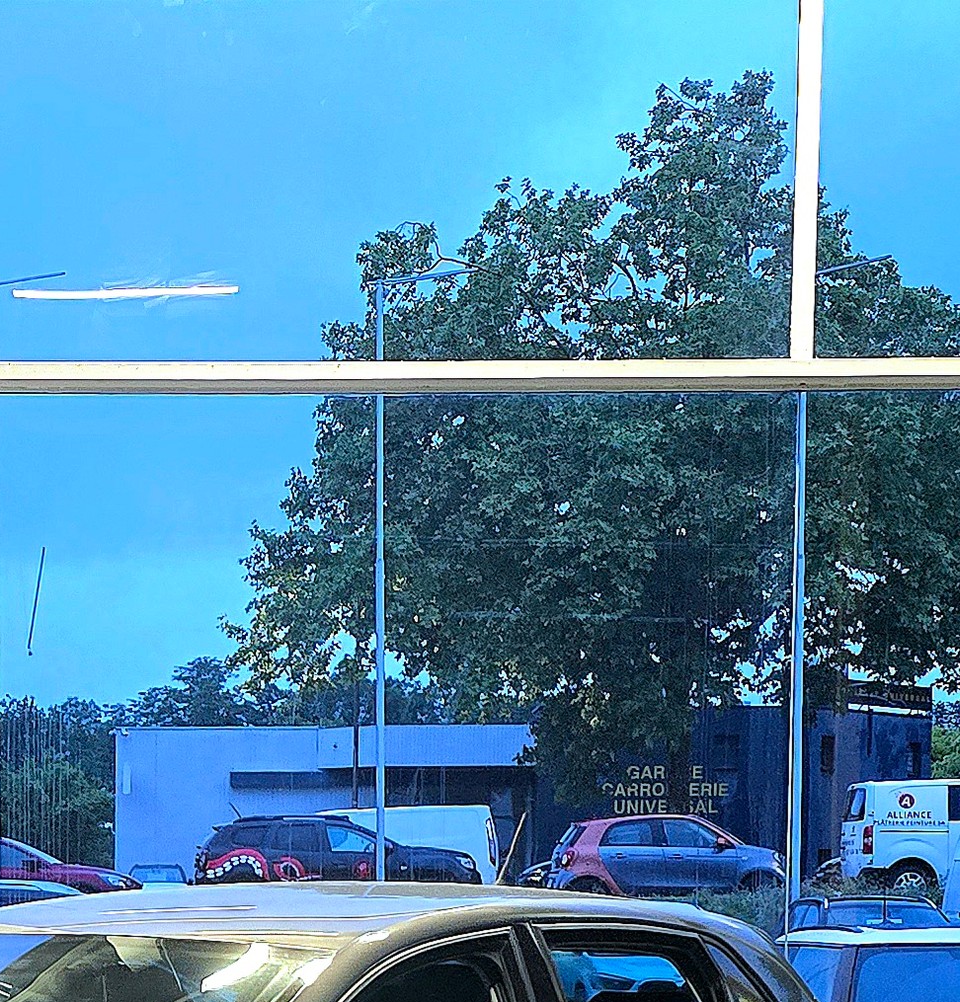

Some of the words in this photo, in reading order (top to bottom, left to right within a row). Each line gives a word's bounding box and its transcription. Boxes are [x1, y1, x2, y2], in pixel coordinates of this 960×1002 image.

[626, 765, 703, 779] GARE
[602, 782, 729, 796] CARROERIE
[613, 799, 718, 813] UNIVEAL
[886, 811, 932, 819] ALLIANCE
